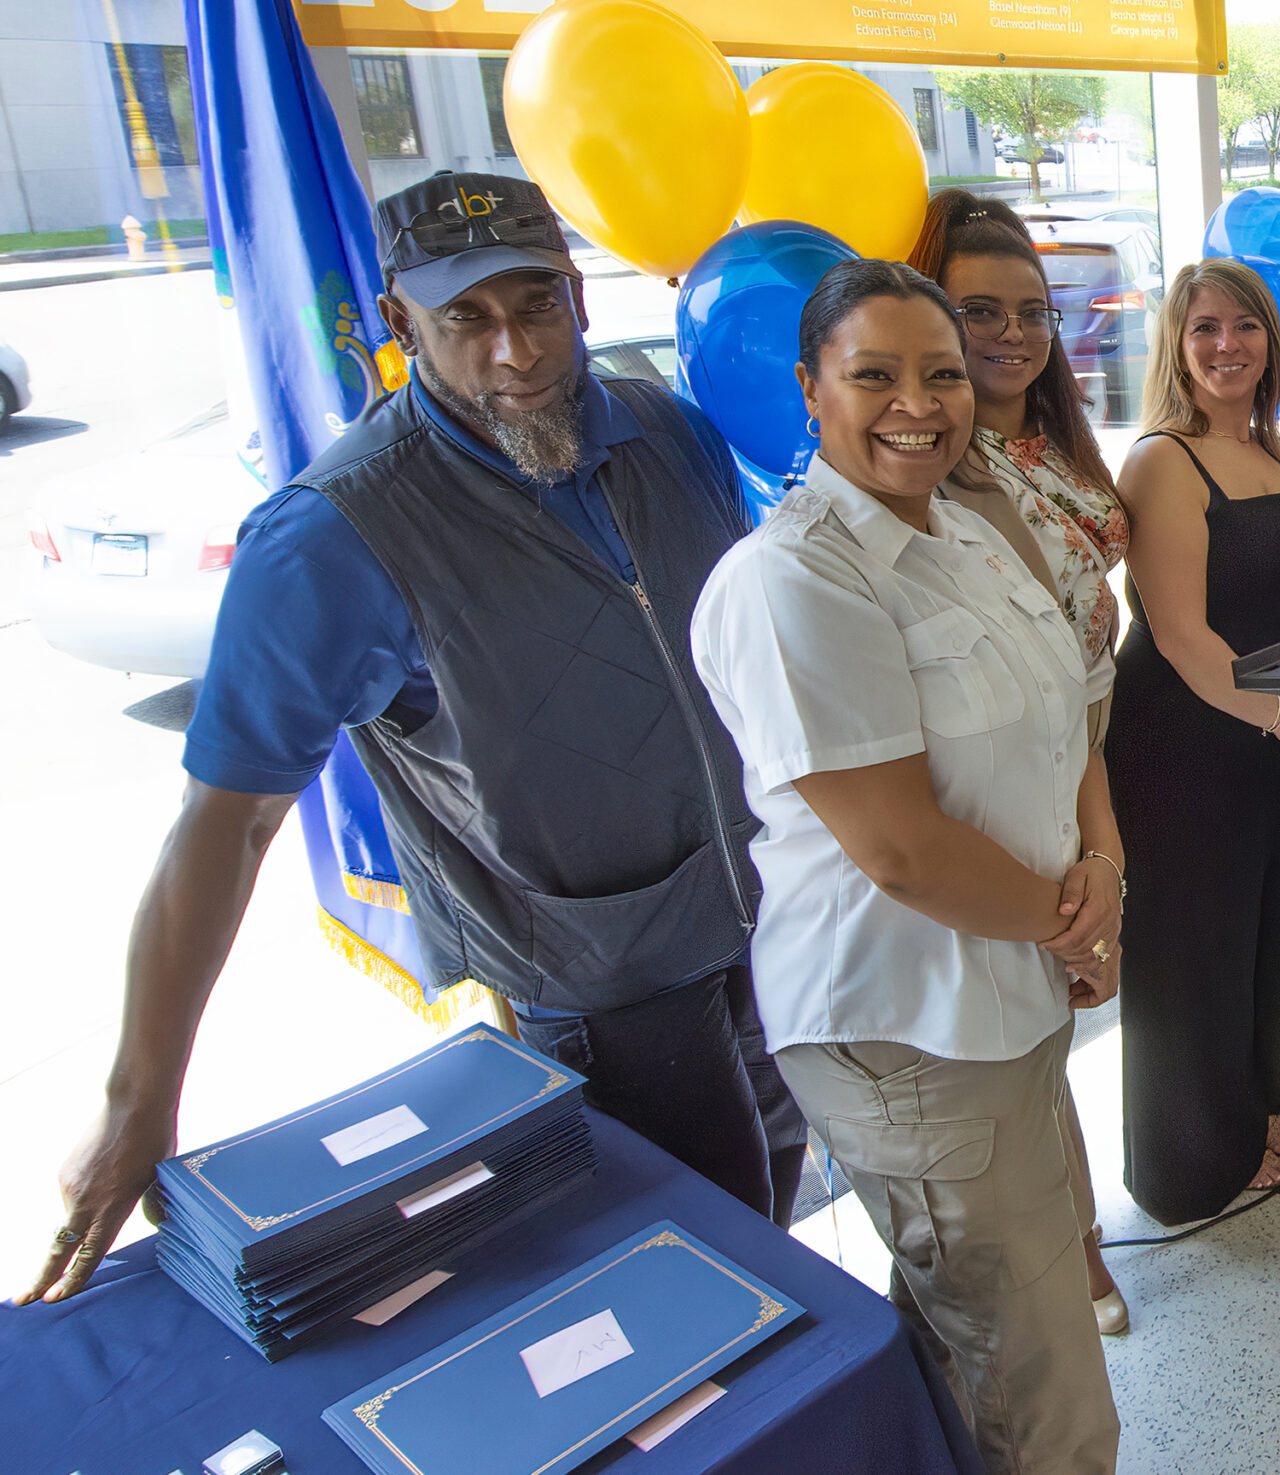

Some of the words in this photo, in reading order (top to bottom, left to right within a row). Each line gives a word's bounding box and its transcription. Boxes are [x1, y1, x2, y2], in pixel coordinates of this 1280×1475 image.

[851, 5, 880, 18] Dean
[1015, 2, 1058, 15] Needham
[990, 16, 1036, 30] Glenwood
[855, 24, 892, 36] Edvard
[1110, 24, 1140, 38] George
